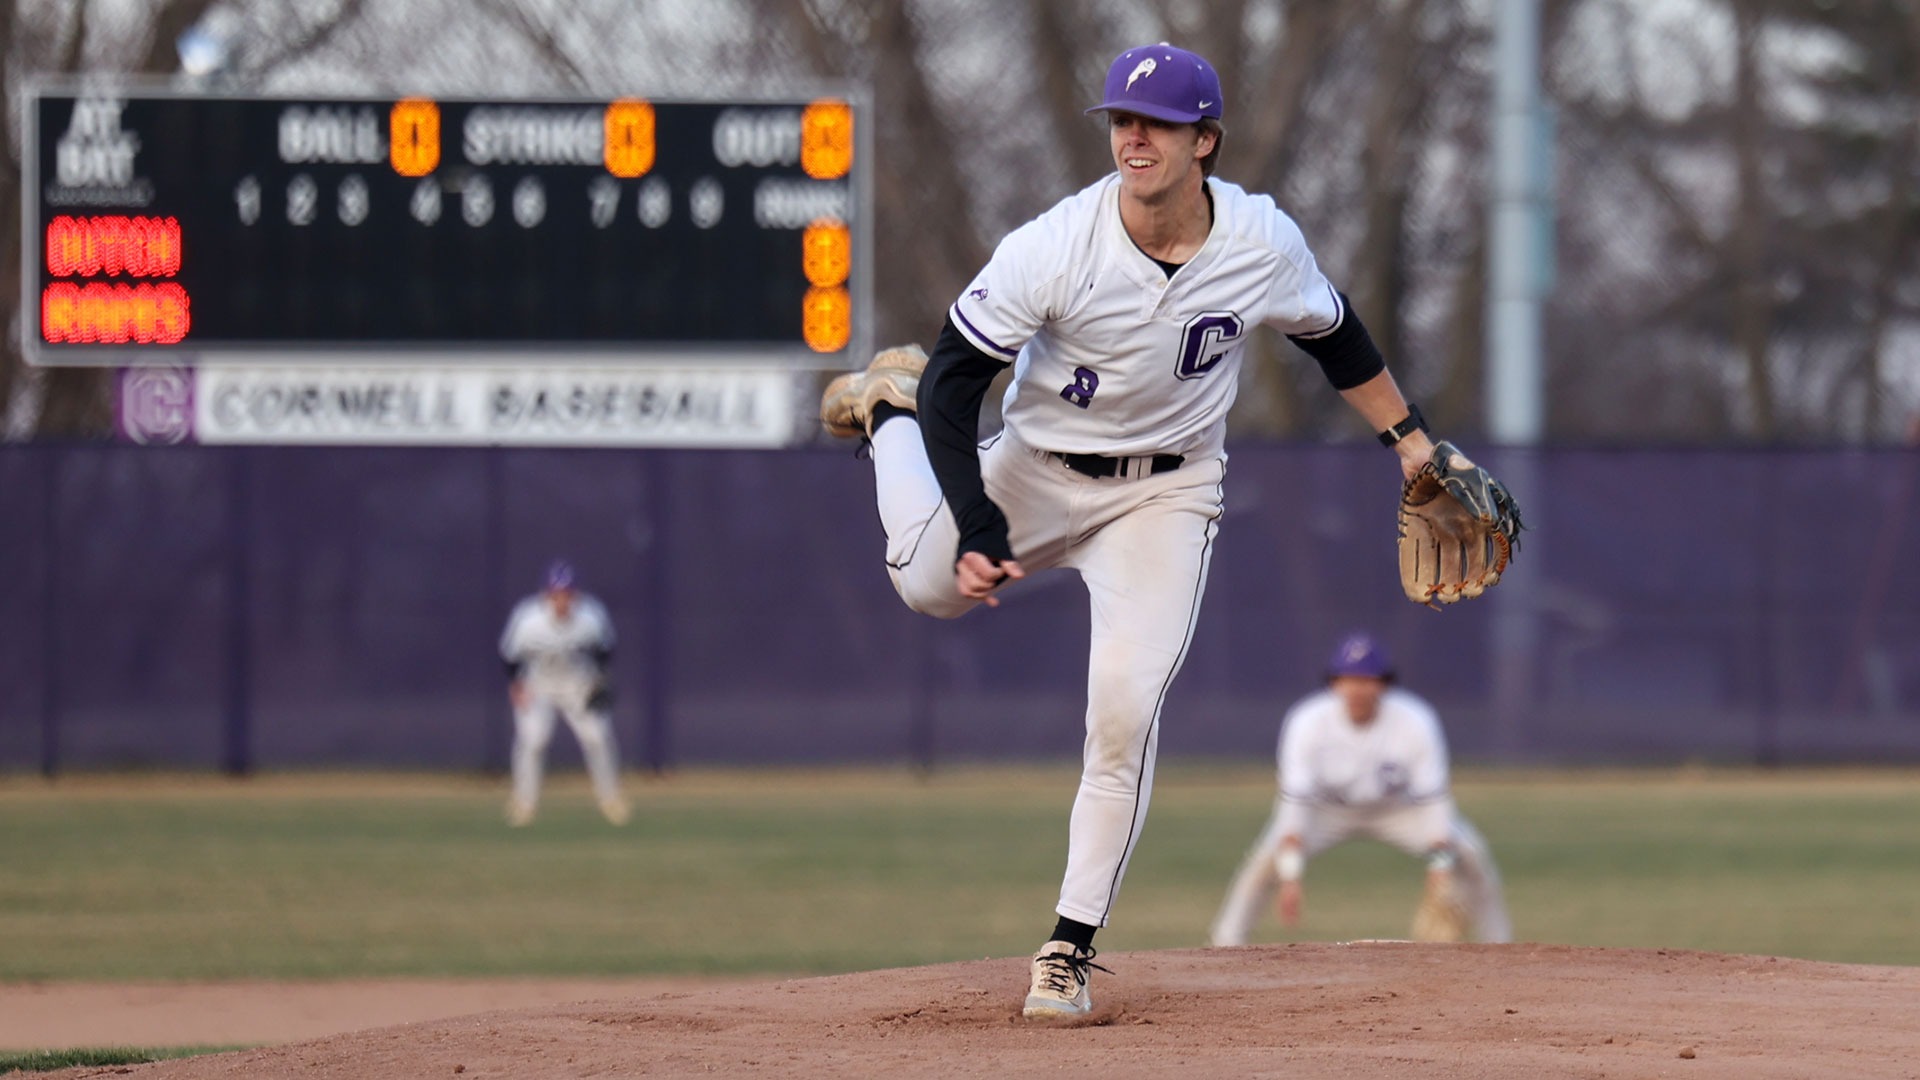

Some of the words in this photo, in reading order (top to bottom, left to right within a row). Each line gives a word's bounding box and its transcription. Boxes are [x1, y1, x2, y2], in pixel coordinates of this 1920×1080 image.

[72, 97, 127, 140] AT
[278, 105, 387, 163] BALL
[463, 105, 605, 165] STRIKE
[712, 107, 802, 167] OUT
[56, 138, 140, 187] BAT
[235, 174, 261, 225] 1
[286, 174, 317, 225] 2
[338, 174, 369, 225] 3
[411, 174, 441, 226] 4
[462, 175, 494, 226] 5
[513, 175, 546, 226] 6
[587, 175, 621, 227] 7
[638, 175, 671, 227] 8
[690, 176, 724, 227] 9
[1175, 310, 1244, 381] C
[122, 370, 191, 444] C
[211, 382, 464, 438] CORNELL
[486, 382, 768, 436] BASEBALL
[1060, 366, 1099, 409] 8
